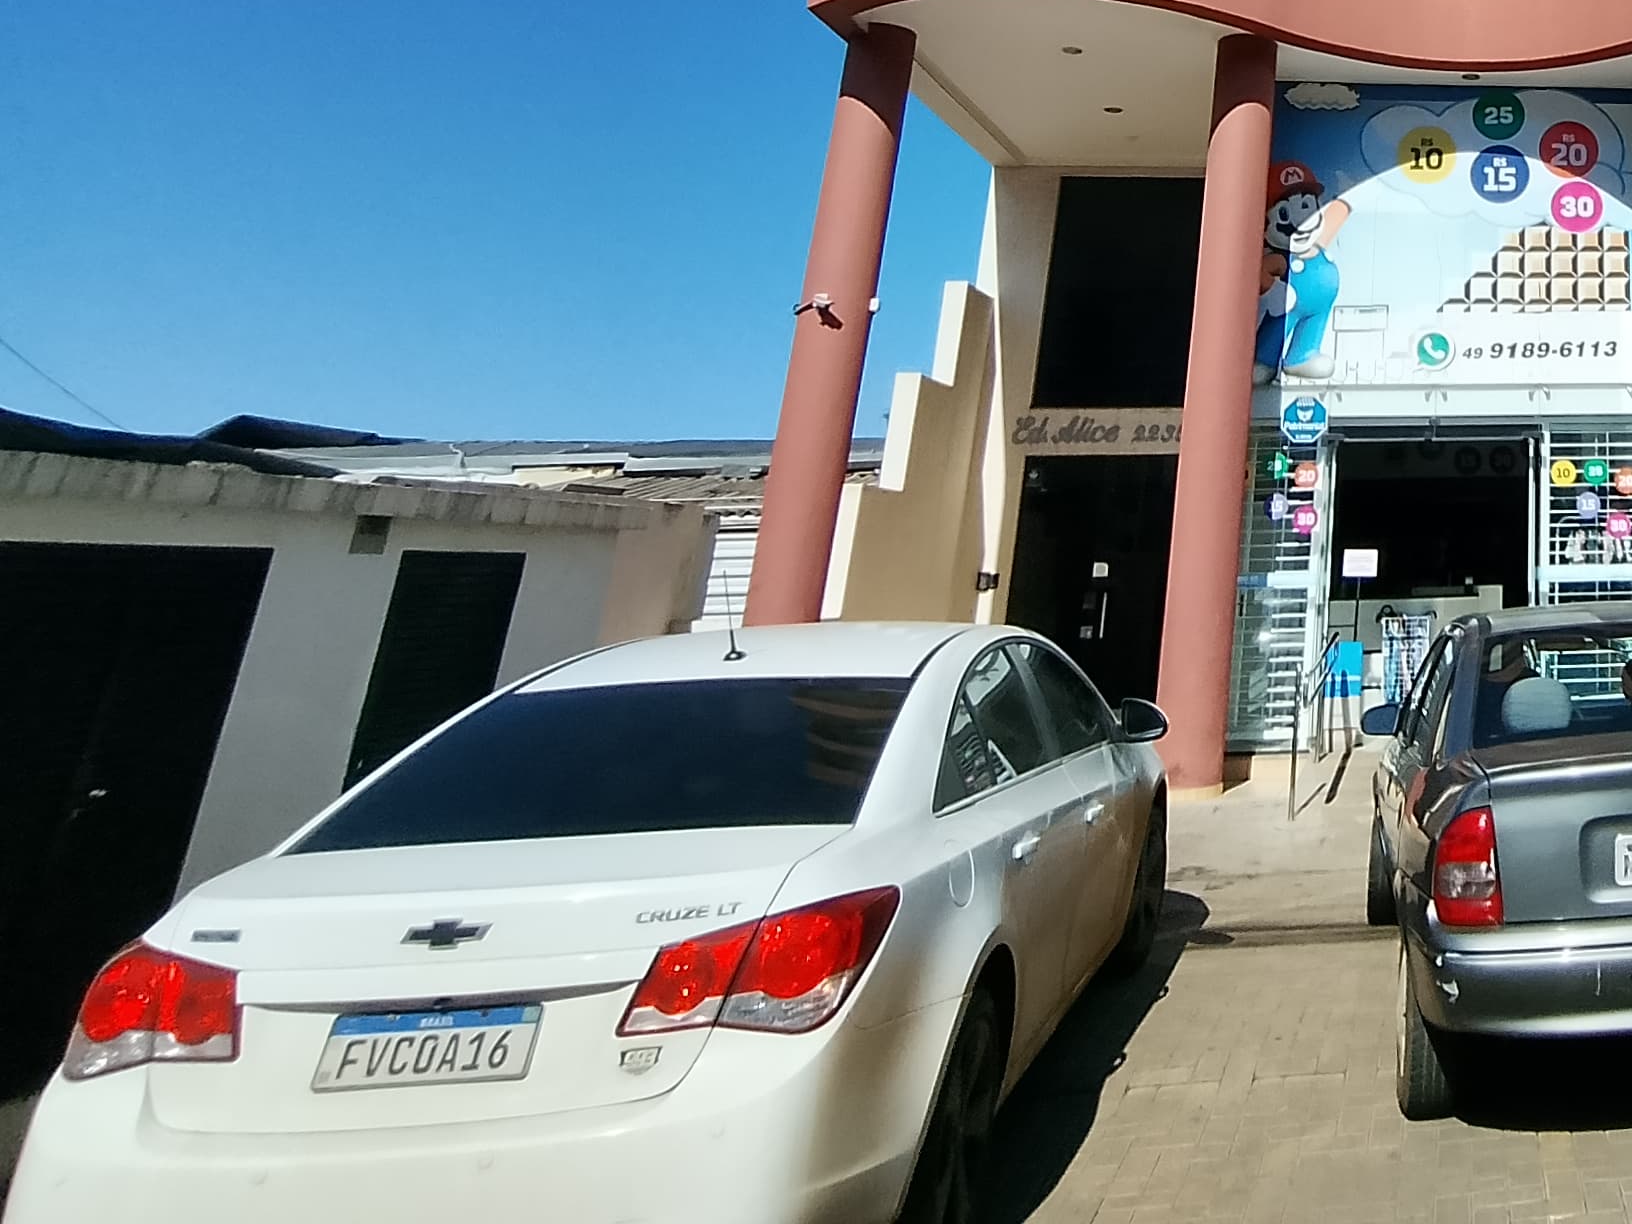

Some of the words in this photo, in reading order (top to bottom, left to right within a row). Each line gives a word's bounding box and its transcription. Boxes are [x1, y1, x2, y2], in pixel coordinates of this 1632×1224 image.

[1484, 106, 1514, 125] 25
[1410, 147, 1443, 170] 10
[1551, 143, 1588, 167] 20
[1483, 166, 1517, 192] 15
[1559, 196, 1595, 218] 30
[1462, 347, 1483, 359] 49
[1489, 340, 1618, 359] 9189-6113
[1299, 470, 1315, 482] 20
[1556, 468, 1571, 479] 10
[1581, 498, 1596, 510] 15
[636, 905, 711, 924] CRUZE
[717, 901, 742, 916] LT
